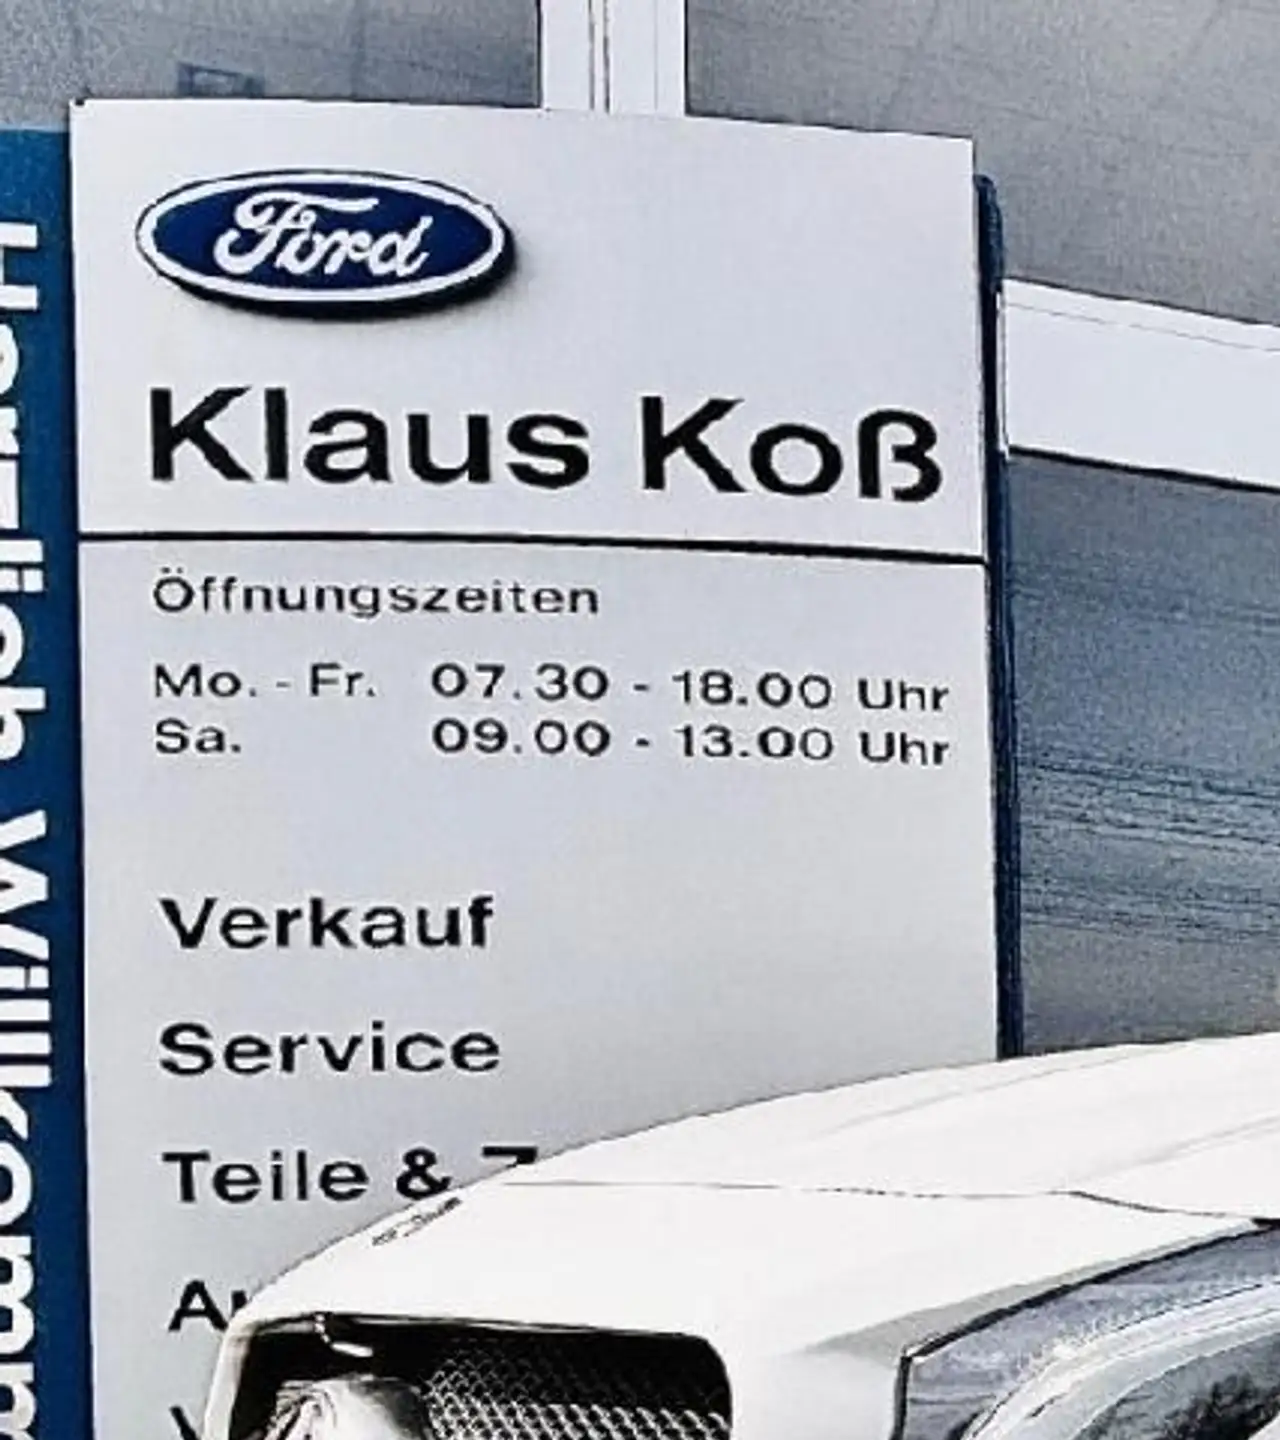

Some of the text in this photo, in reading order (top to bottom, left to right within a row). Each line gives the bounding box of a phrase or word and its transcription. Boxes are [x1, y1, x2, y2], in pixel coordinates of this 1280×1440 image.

[213, 191, 434, 275] Ford
[150, 386, 943, 503] Klaus Koß
[152, 568, 600, 620] Öffnungszeiten
[154, 663, 257, 698] Mo.
[311, 662, 375, 698] Fr.
[431, 662, 610, 702] 07.30
[672, 670, 832, 710] 18.00
[857, 678, 950, 714] Uhr
[155, 718, 241, 755] Sa.
[432, 718, 611, 759] 09.00
[676, 724, 835, 762] 13.00
[859, 731, 950, 769] Uhr
[159, 896, 494, 950] Verkauf
[159, 1020, 501, 1076] Service
[161, 1149, 370, 1205] Teile
[395, 1146, 452, 1201] &
